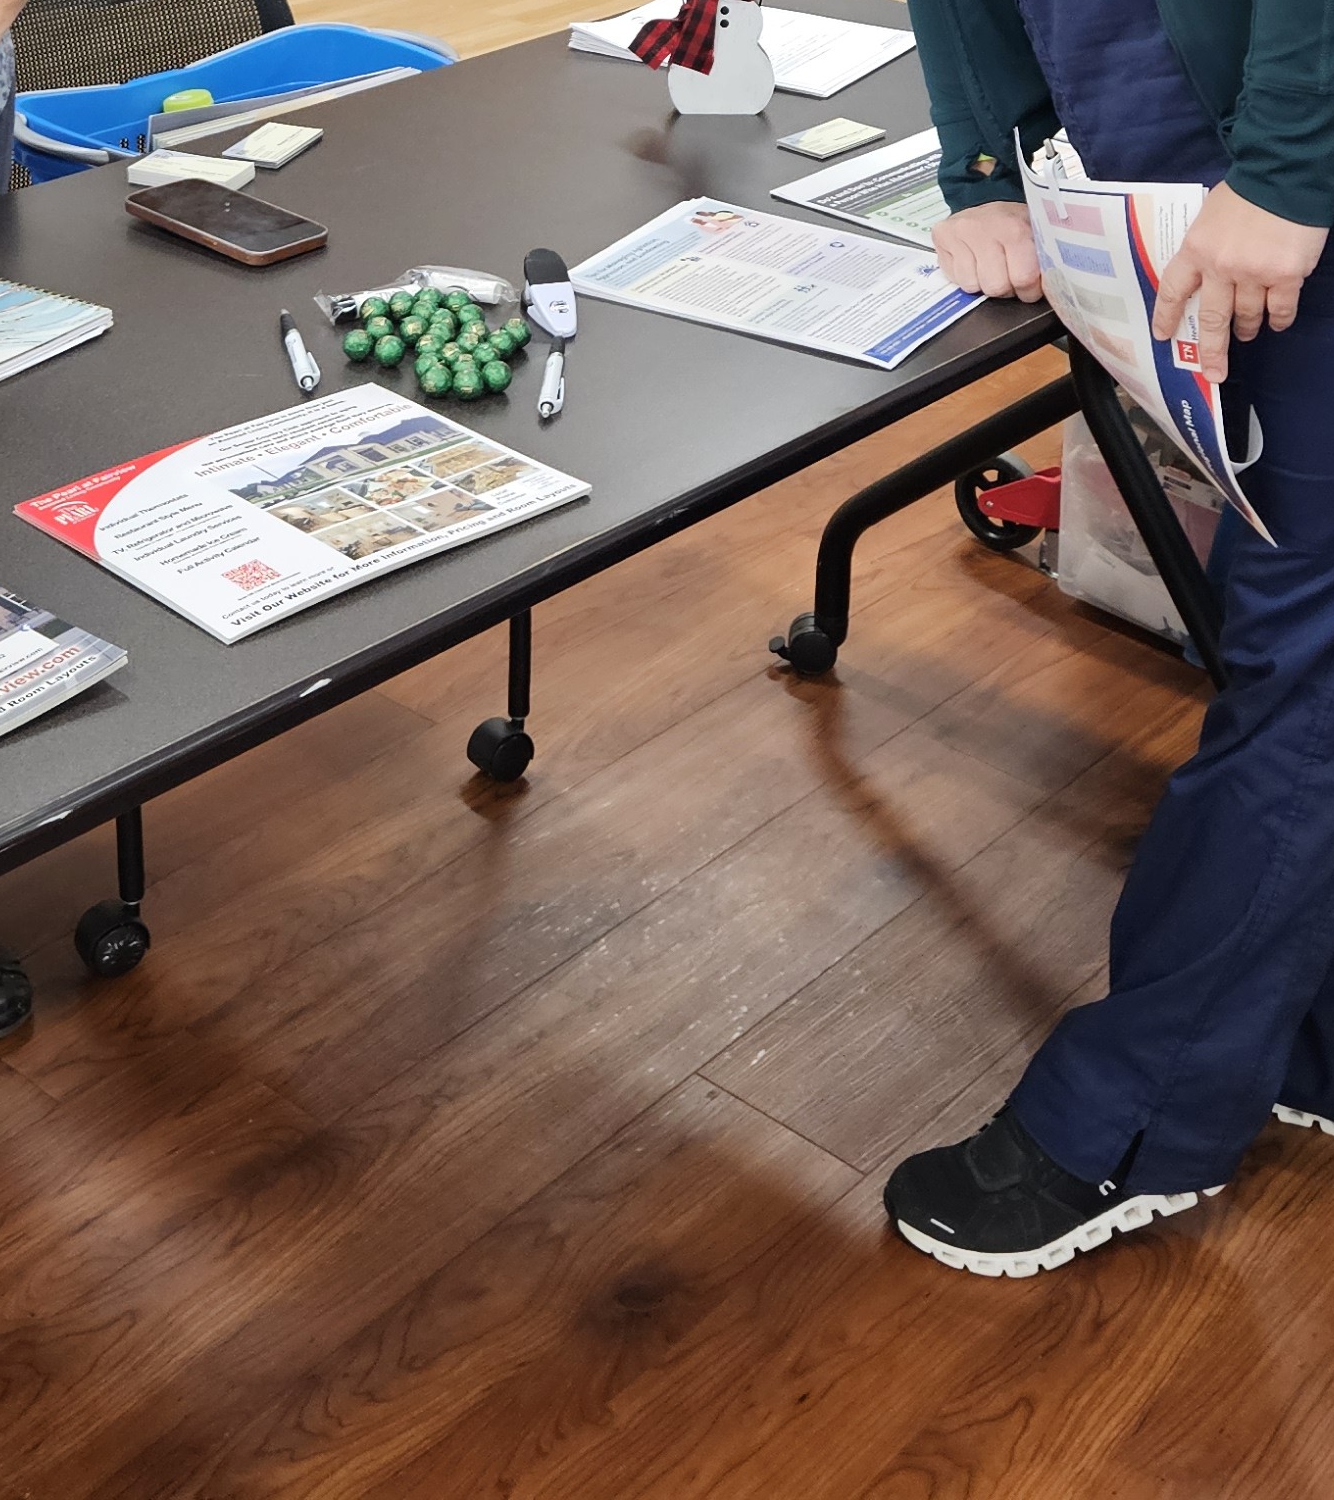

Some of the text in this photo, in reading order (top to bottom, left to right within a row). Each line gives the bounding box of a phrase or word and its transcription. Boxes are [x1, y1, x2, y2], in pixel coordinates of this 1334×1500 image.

[1183, 344, 1193, 360] TN
[1181, 400, 1192, 427] Map
[191, 402, 414, 479] Intimate Elegant Comfortable
[27, 496, 55, 508] The
[49, 485, 84, 499] Pearl
[51, 503, 103, 525] PEARL
[228, 610, 264, 626] Visit
[259, 599, 287, 611] Our
[282, 577, 334, 600] Website
[330, 569, 351, 579] for
[349, 557, 382, 572] More
[379, 531, 449, 561] Information,
[446, 518, 488, 536] Pricing
[483, 511, 508, 522] and
[504, 499, 538, 513] Room
[534, 483, 580, 502] Layouts
[3, 684, 49, 707] Room
[44, 654, 98, 686] Layouts
